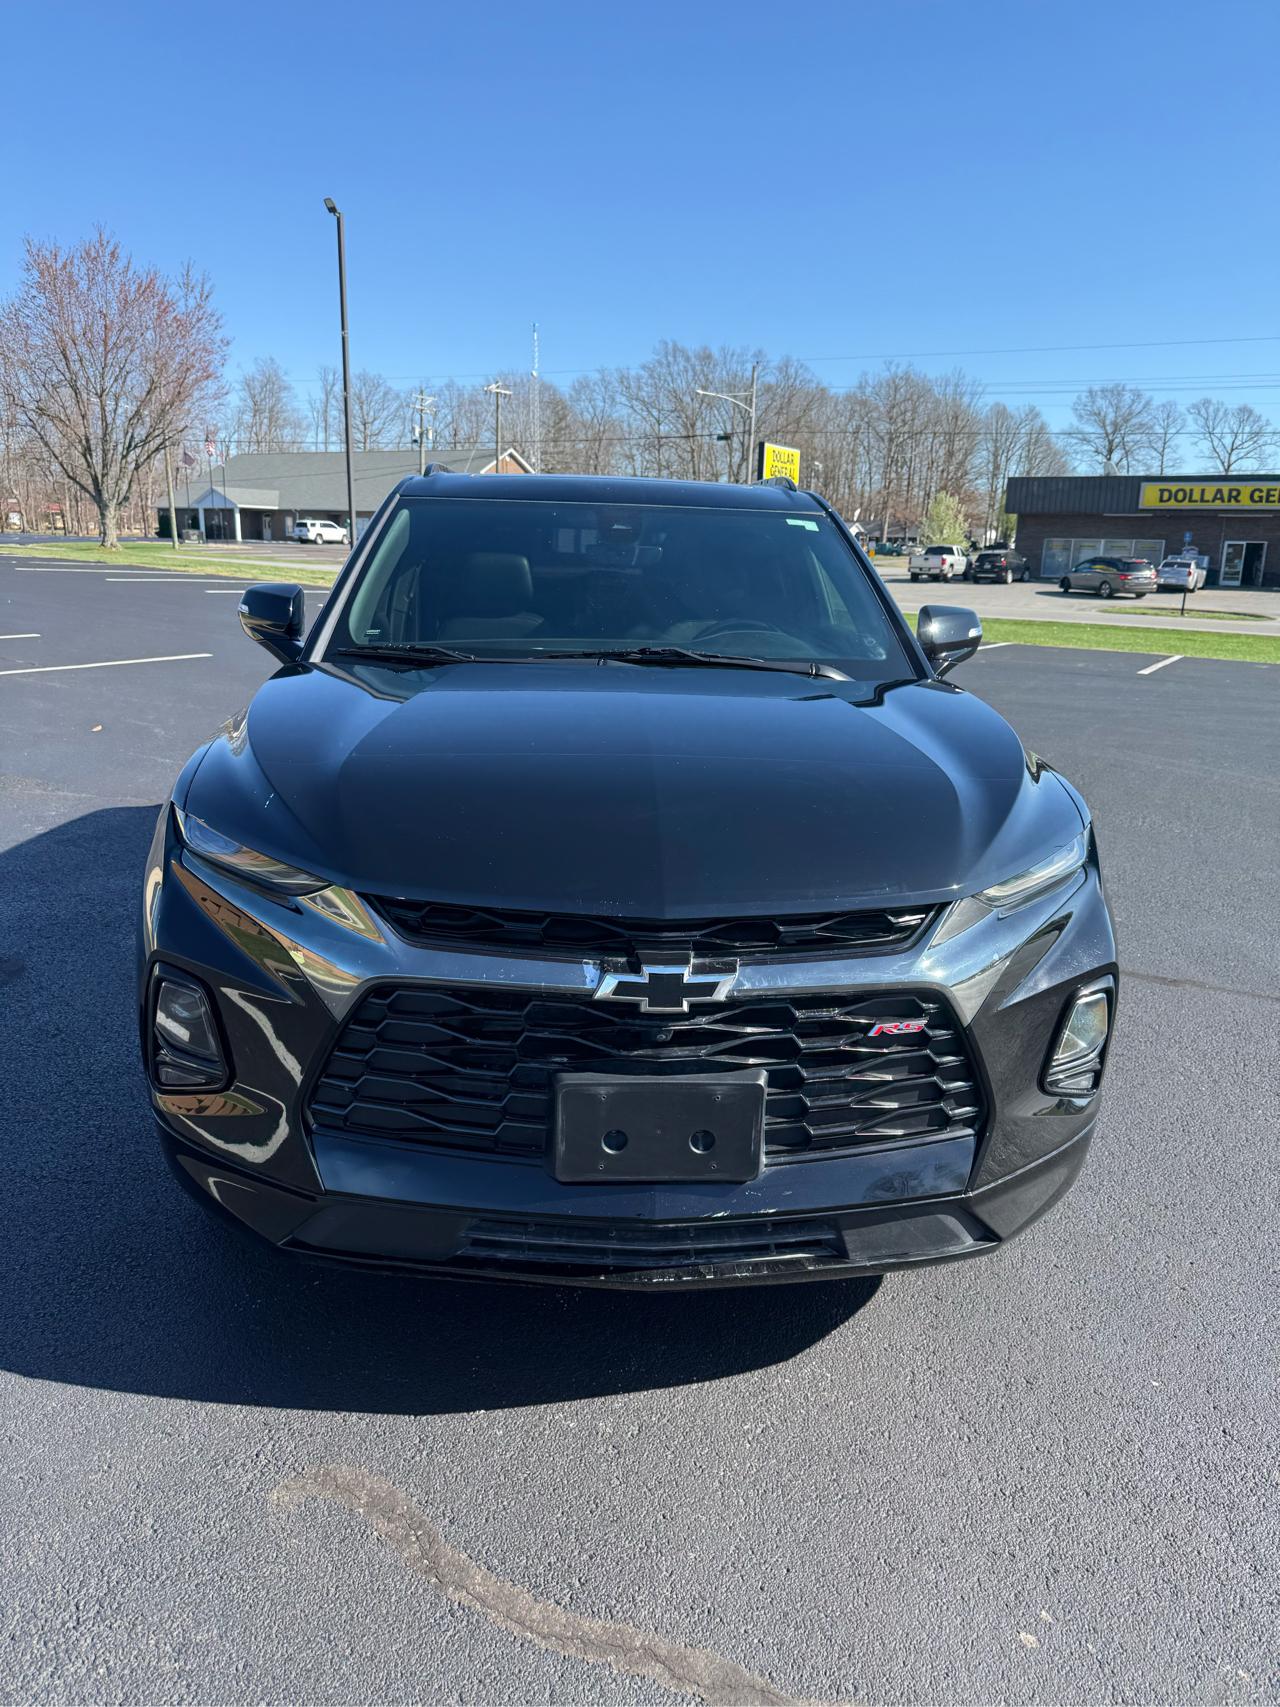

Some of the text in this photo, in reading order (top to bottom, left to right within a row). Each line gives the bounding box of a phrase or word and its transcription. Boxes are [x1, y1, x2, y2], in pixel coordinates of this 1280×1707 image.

[772, 450, 795, 465] DOLLAR
[1158, 488, 1280, 503] DOLLAR GE
[868, 1020, 926, 1037] RS
